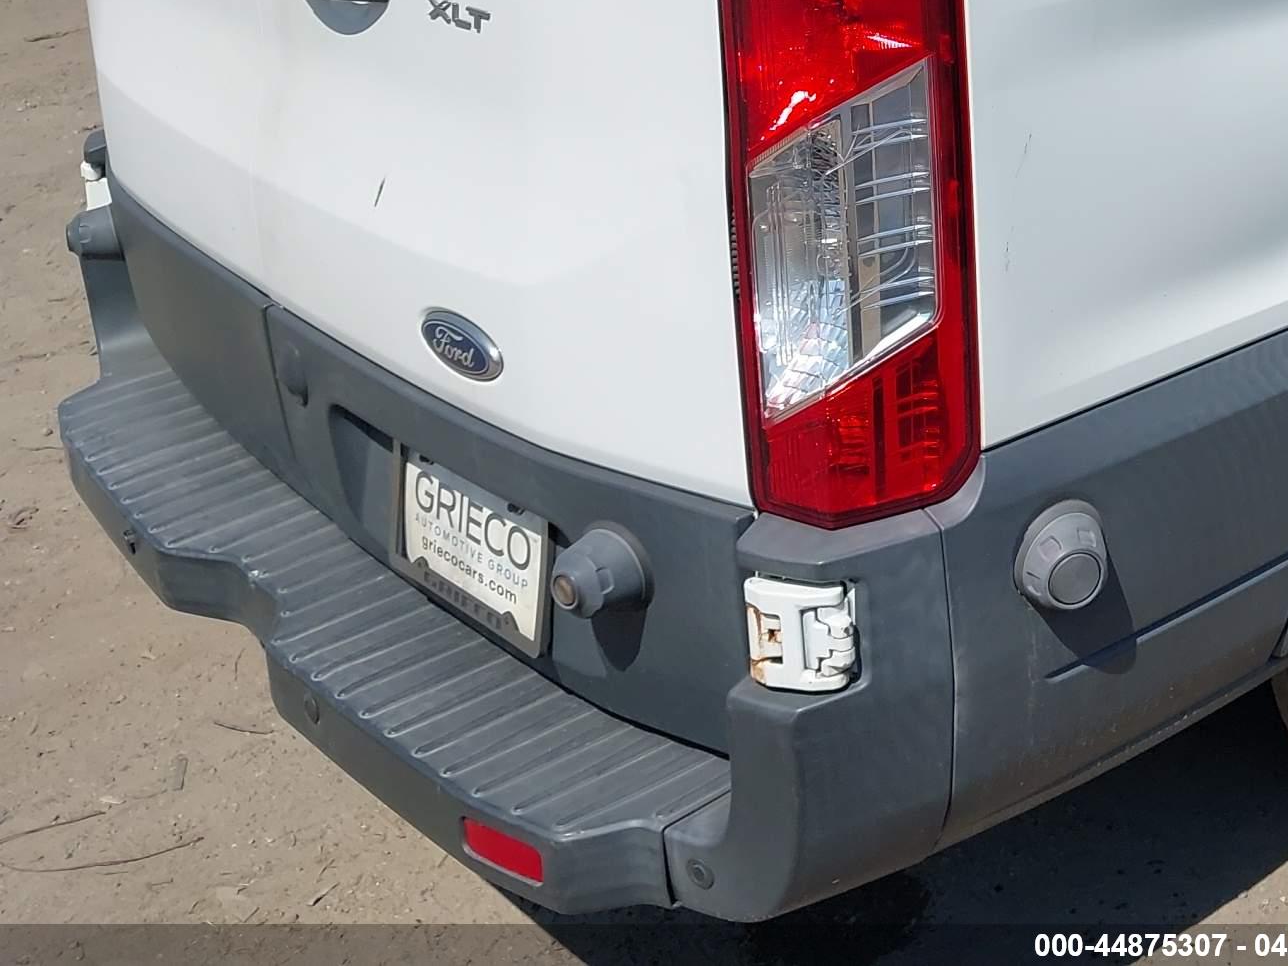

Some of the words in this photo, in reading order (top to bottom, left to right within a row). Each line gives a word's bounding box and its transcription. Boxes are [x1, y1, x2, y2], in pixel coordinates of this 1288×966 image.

[433, 326, 475, 368] Ford
[415, 470, 531, 570] GRIECO
[415, 513, 483, 564] AUTOMOTIVE
[488, 559, 529, 589] GROUP
[422, 536, 517, 605] griecocars.com
